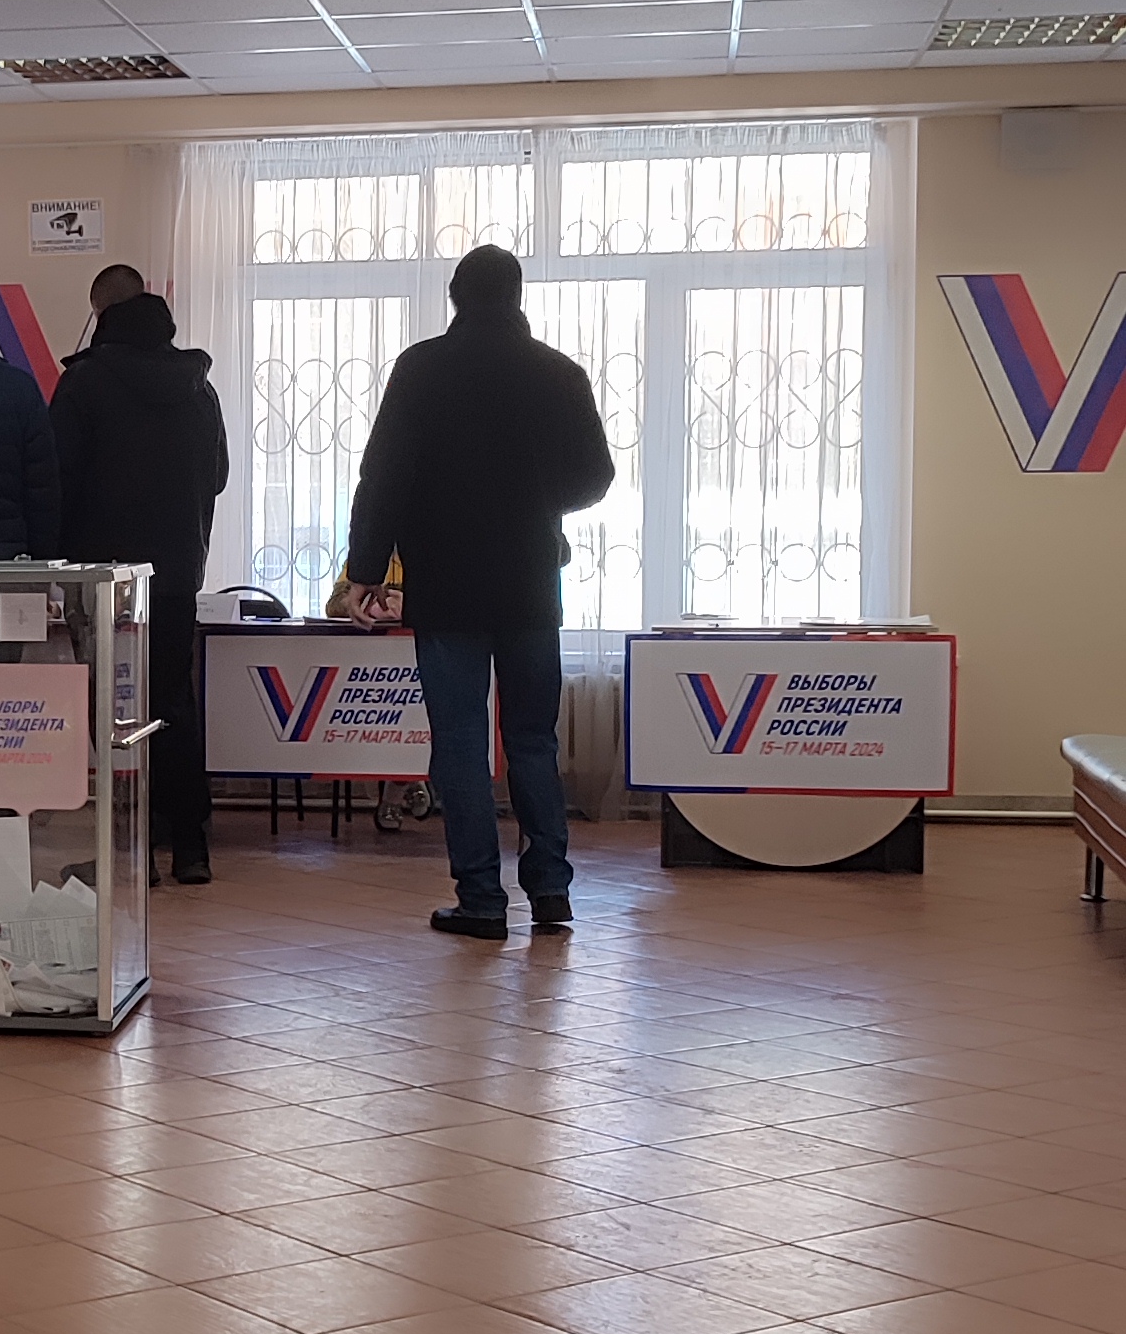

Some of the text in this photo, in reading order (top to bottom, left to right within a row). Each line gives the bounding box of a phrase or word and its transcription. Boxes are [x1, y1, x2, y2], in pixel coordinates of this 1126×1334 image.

[32, 201, 100, 212] ВНИМАНИЕ!
[787, 674, 877, 691] ВЫБОРЫ
[338, 688, 423, 706] ПРЕЗИДЕ
[777, 697, 902, 716] ПРЕЗИДЕНТА
[329, 709, 403, 725] РОССИИ
[767, 720, 848, 736] РОССИИ
[360, 730, 402, 743] МАРТА
[800, 742, 846, 756] МАРТА
[849, 743, 884, 757] 2024
